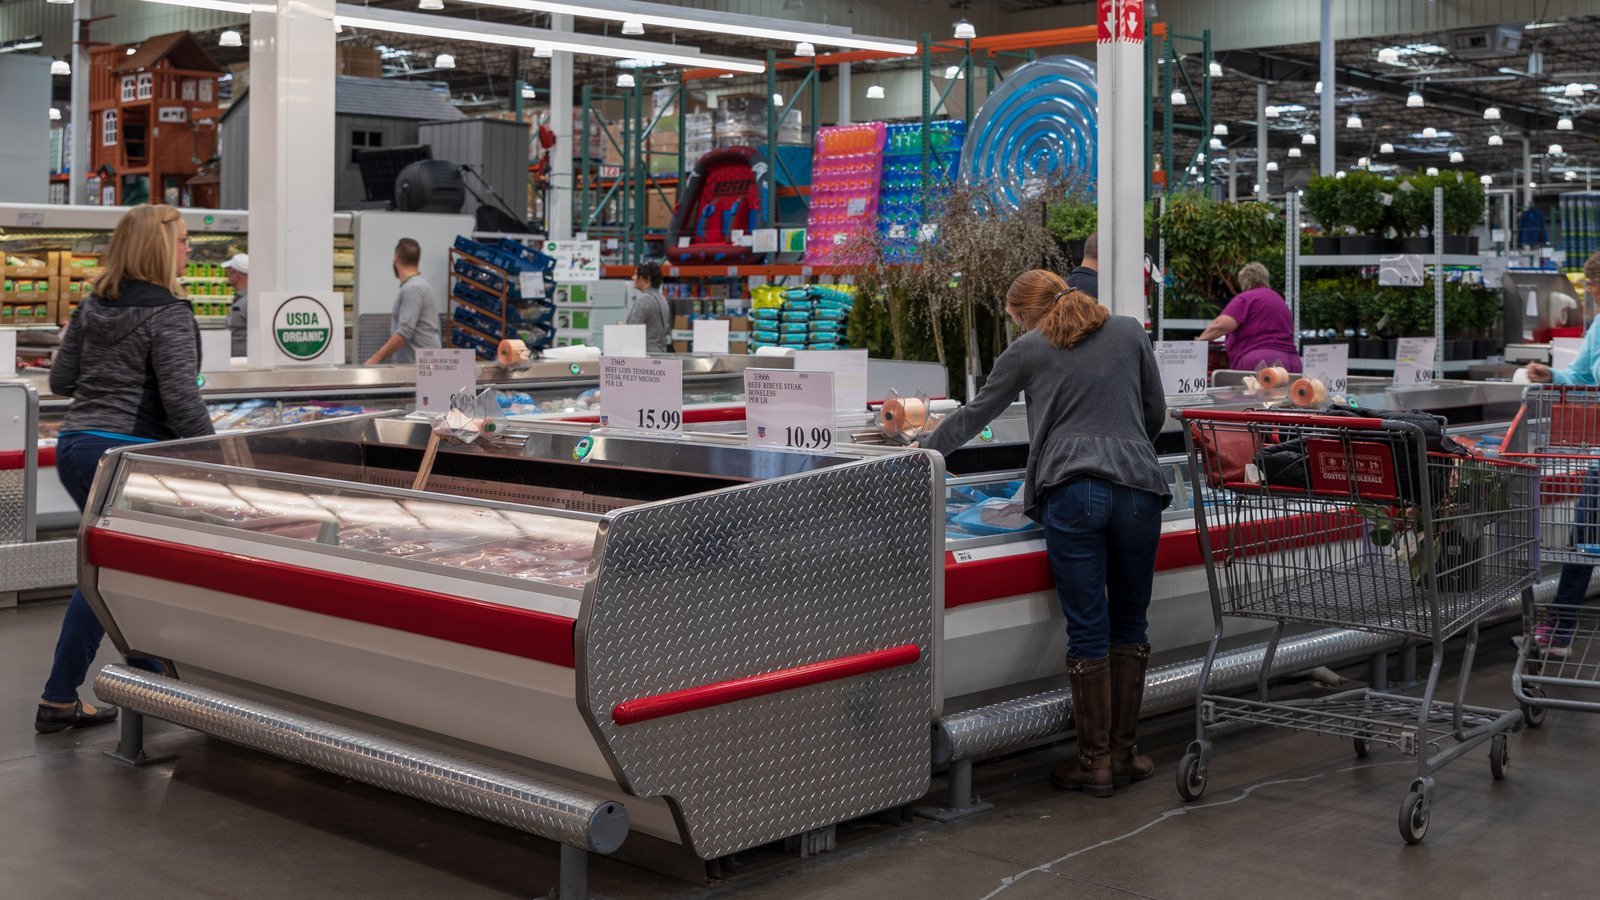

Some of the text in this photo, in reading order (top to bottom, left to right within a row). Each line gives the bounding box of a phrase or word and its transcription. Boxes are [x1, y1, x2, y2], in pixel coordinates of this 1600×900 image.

[286, 312, 319, 325] USDA
[282, 331, 325, 343] ORGANIC
[610, 358, 625, 366] 33605
[633, 368, 666, 377] TENDERLOIN
[753, 372, 770, 381] 33666
[1415, 369, 1432, 383] 8.99
[638, 375, 661, 383] MIGNON
[748, 381, 803, 391] BEEF RIBEYE STEAK
[1178, 377, 1206, 394] 26.99
[748, 389, 777, 397] BONELESS
[748, 396, 759, 404] PER
[637, 408, 681, 431] 15.99
[785, 426, 832, 450] 10.99
[1323, 472, 1383, 484] COSTCO OLESALE
